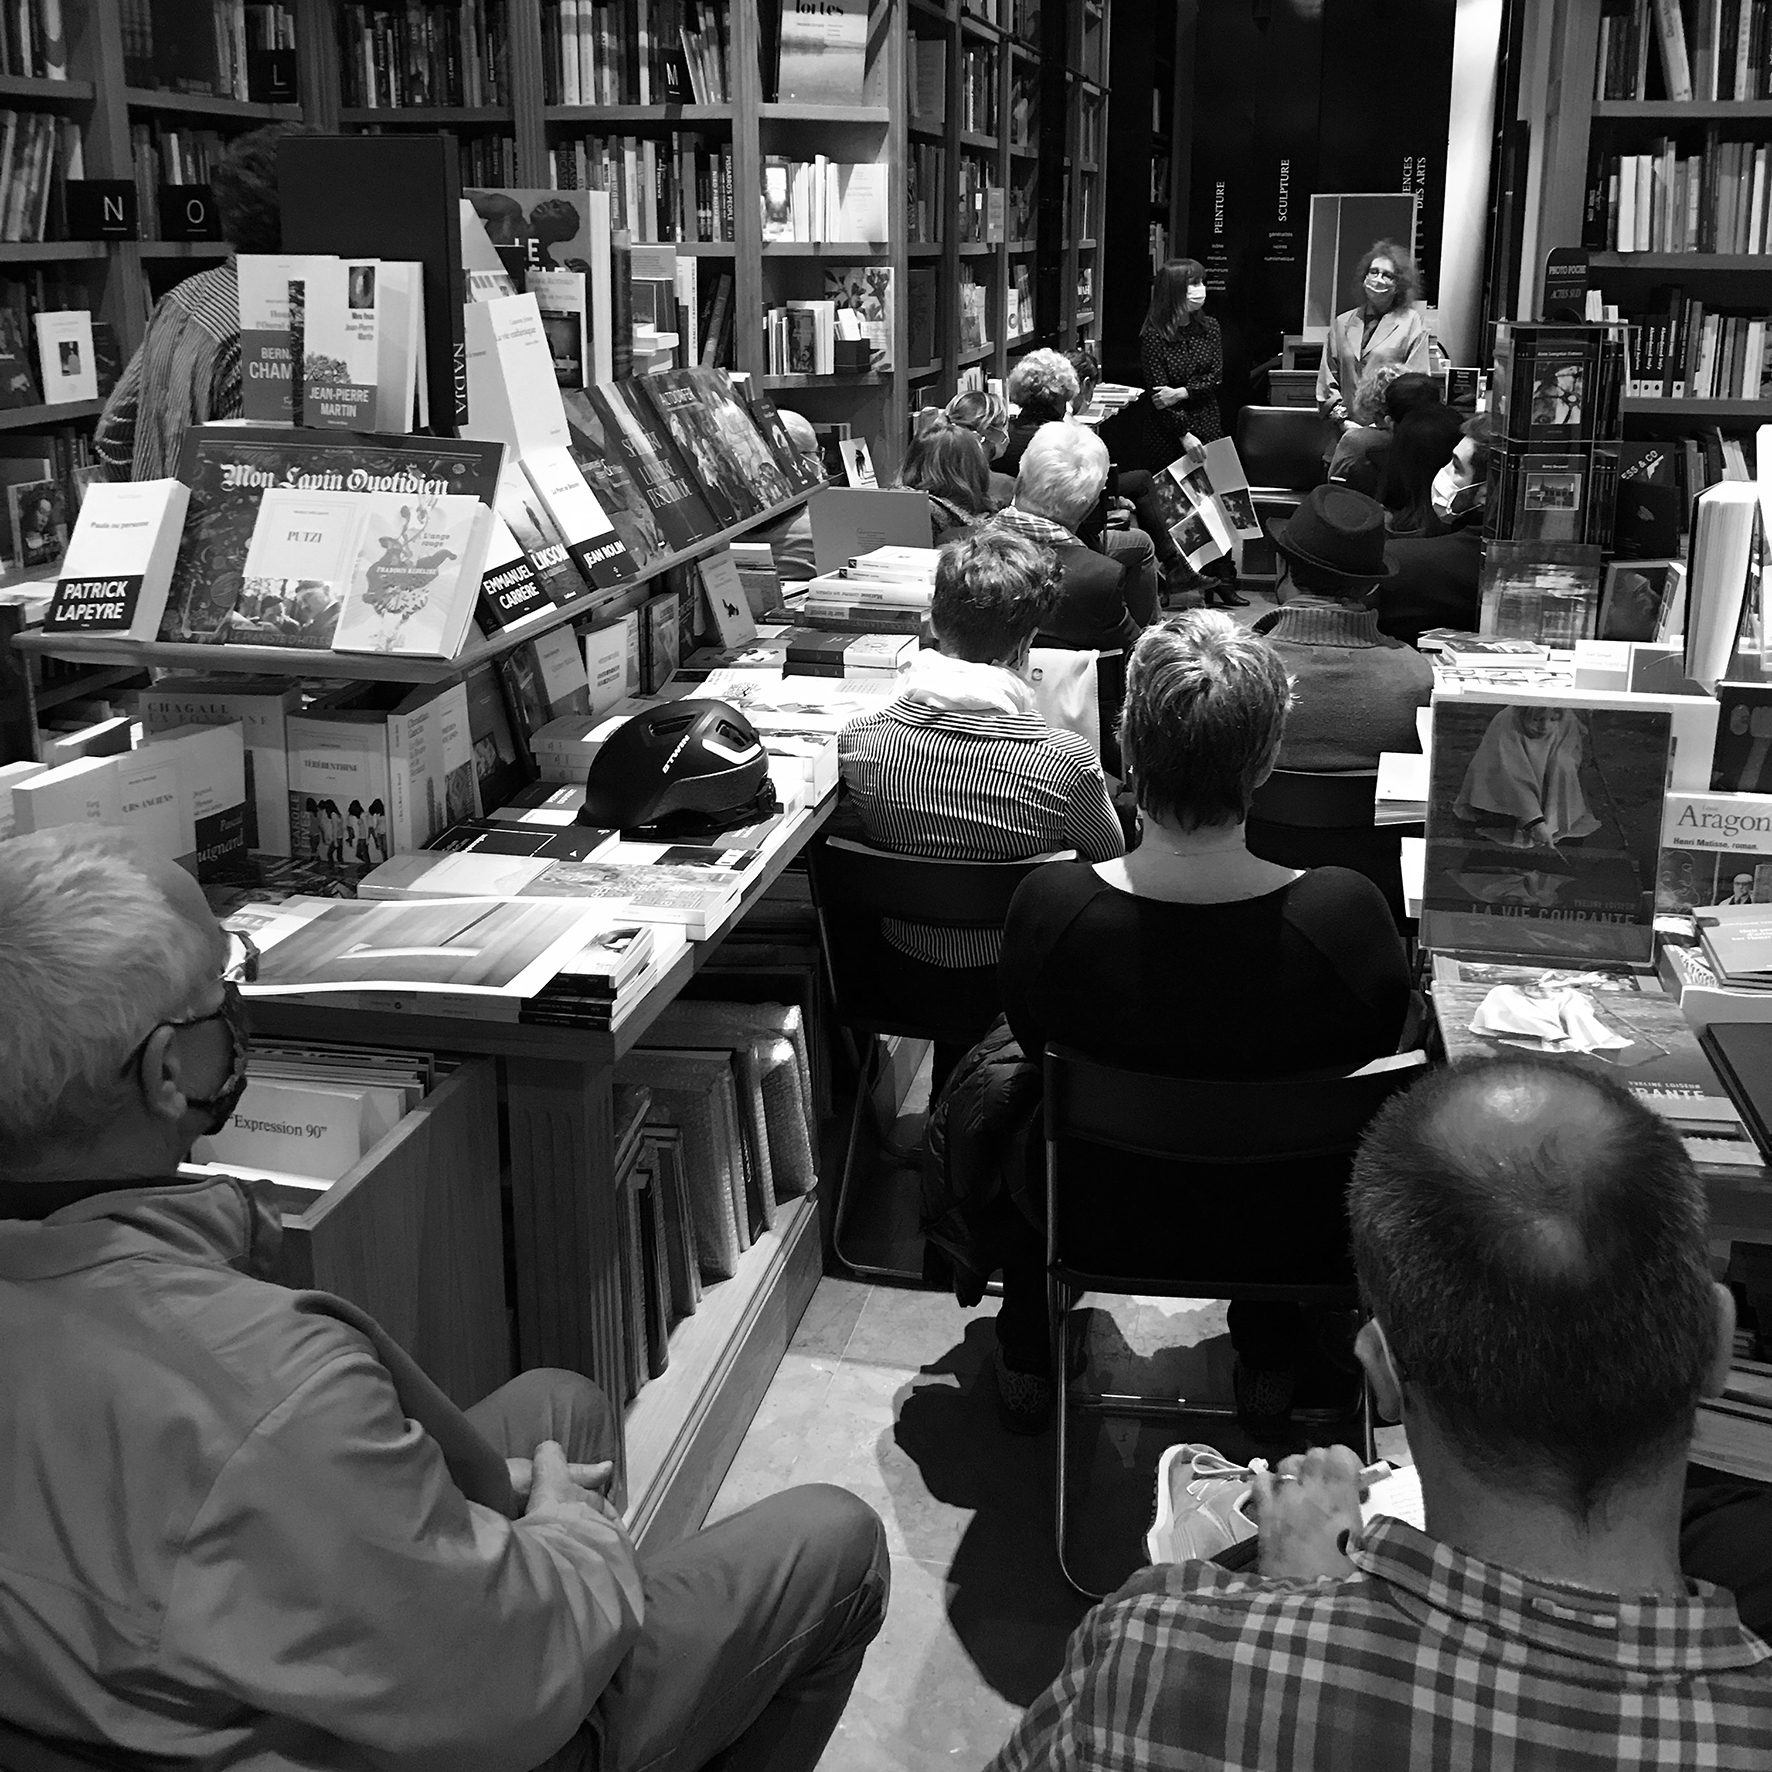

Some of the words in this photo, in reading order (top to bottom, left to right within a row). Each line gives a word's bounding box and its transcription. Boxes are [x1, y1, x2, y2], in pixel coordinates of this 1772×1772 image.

[273, 64, 287, 86] L
[665, 62, 679, 86] M
[725, 155, 733, 195] PISSARRO'S
[1416, 157, 1427, 185] ARTS
[1278, 159, 1290, 222] SCULPTURE
[103, 195, 123, 222] N
[186, 199, 205, 224] O
[726, 196, 734, 221] PEOPLE
[1214, 181, 1225, 234] PEINTURE
[260, 347, 292, 360] BERN
[452, 342, 467, 415] NADJA
[308, 387, 369, 403] JEAN-PIERRE
[320, 403, 357, 418] MARTIN
[220, 463, 274, 492] Mon
[279, 467, 343, 490] Lapin
[346, 463, 449, 496] Quotidien
[286, 531, 323, 543] PUTZI
[423, 533, 450, 541] L'ange
[582, 548, 605, 570] JEAN
[601, 540, 627, 560] ROLIN
[63, 580, 129, 600] PATRICK
[482, 564, 535, 595] EMMANUEL
[499, 581, 540, 609] CARRÈRE
[55, 602, 125, 621] LAPEYRE
[147, 702, 229, 714] CHAGALL
[219, 811, 244, 832] Pascal
[291, 795, 300, 848] CAROLE
[300, 810, 310, 848] FIVES
[1677, 804, 1771, 837] Aragon
[196, 828, 244, 863] uignard
[1673, 837, 1695, 846] Henri
[1696, 839, 1730, 849] Matisse,
